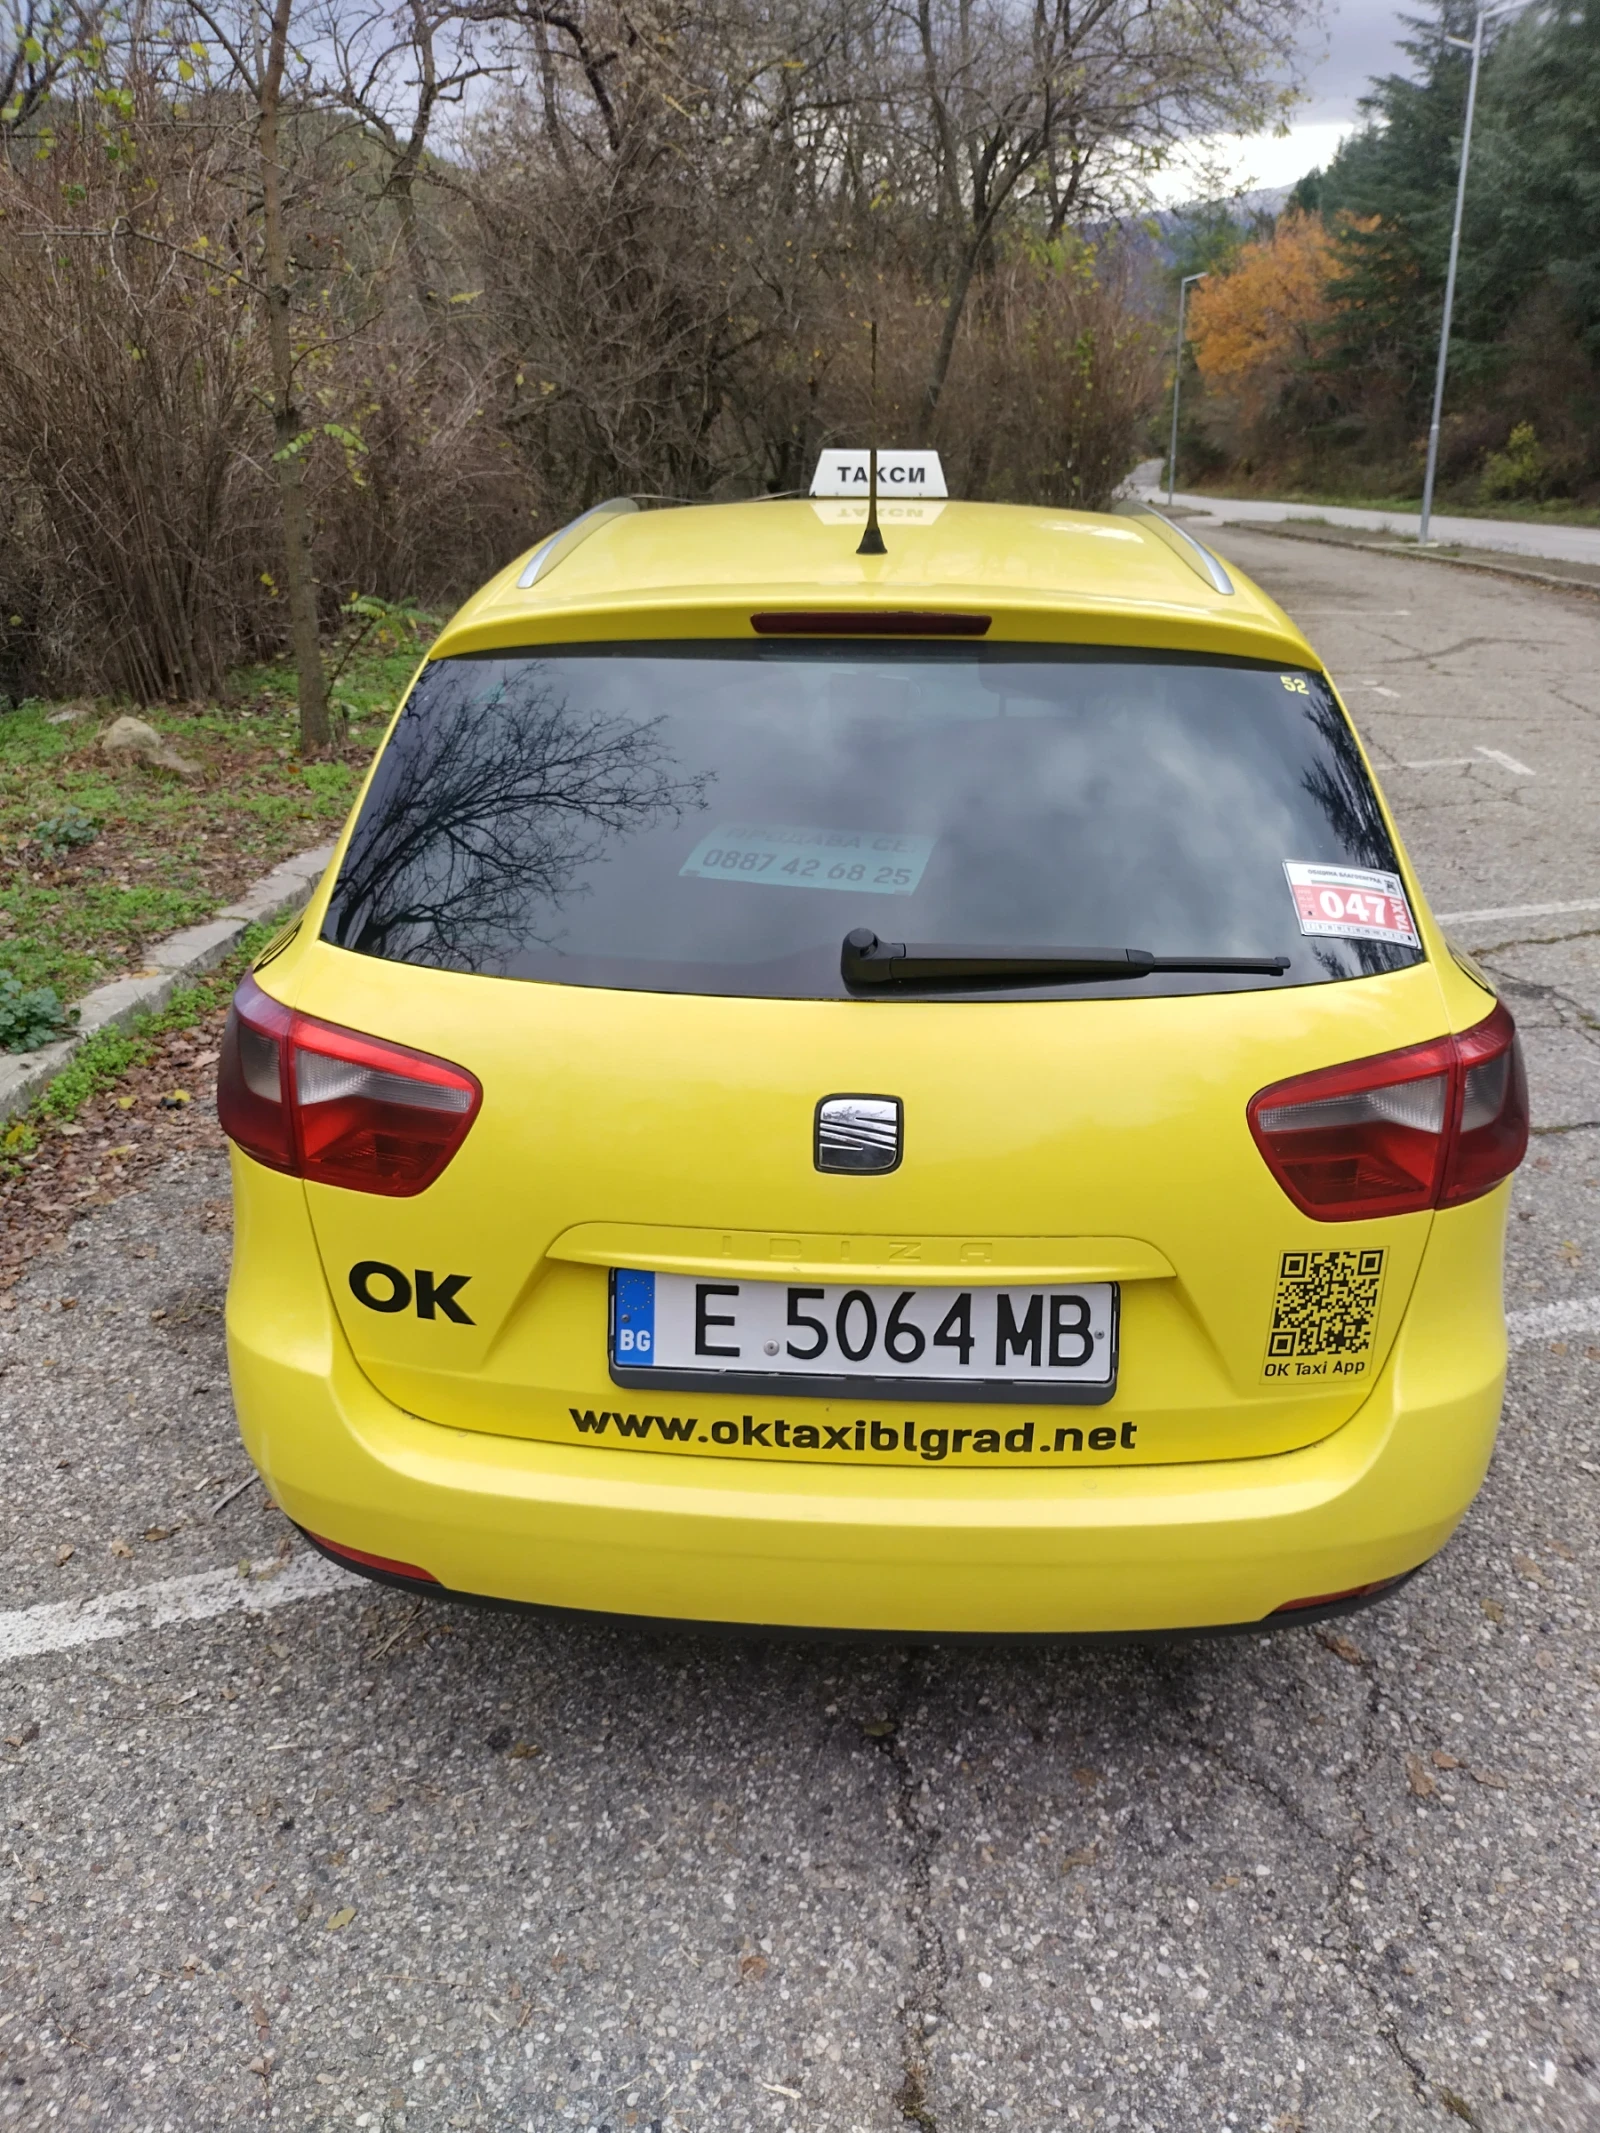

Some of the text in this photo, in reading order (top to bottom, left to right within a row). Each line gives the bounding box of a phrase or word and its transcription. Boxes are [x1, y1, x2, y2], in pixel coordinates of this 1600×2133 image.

[837, 466, 925, 483] ТАКСИ
[1280, 675, 1309, 695] 52
[702, 848, 913, 886] 0887 42 68 25
[1319, 890, 1386, 925] 047
[1389, 897, 1411, 931] TAXI
[348, 1260, 478, 1326] OK
[620, 1329, 651, 1351] BG
[695, 1284, 1094, 1367] E 5064 MB
[1264, 1361, 1365, 1377] OK Taxi App
[568, 1408, 1137, 1460] www.oktaxiblgrad.net
